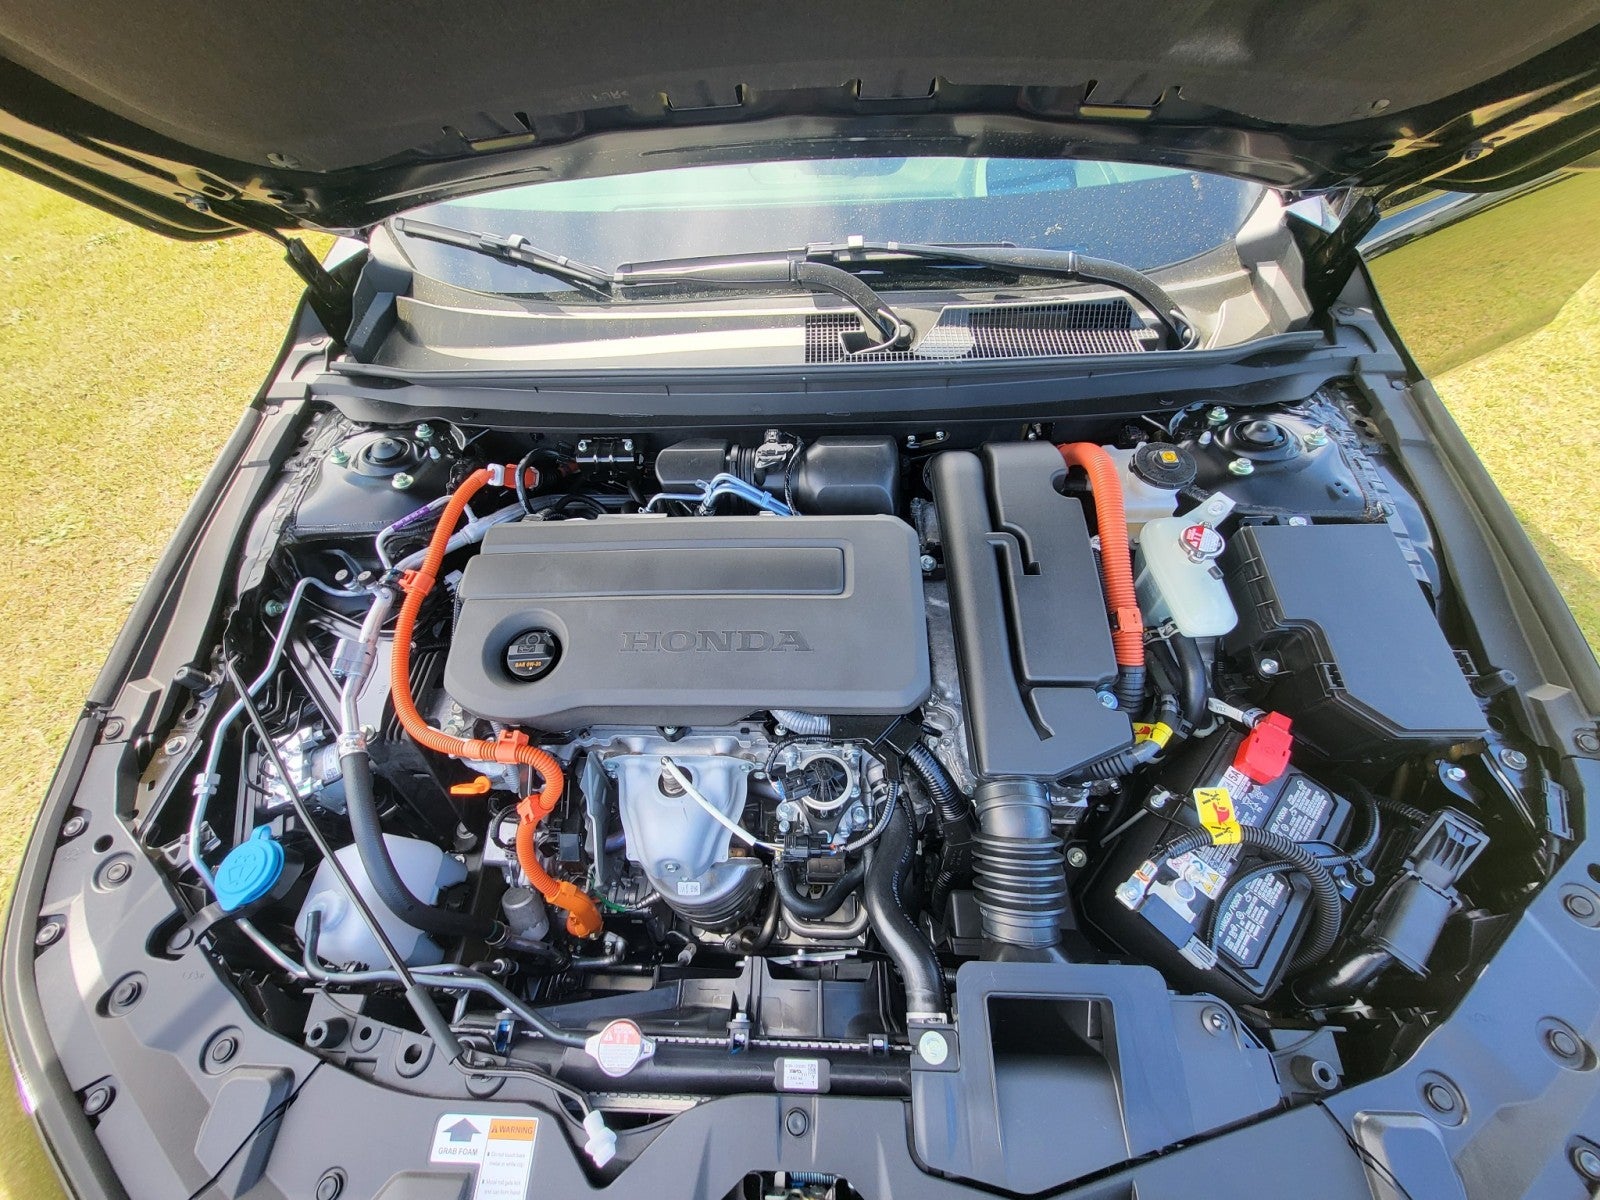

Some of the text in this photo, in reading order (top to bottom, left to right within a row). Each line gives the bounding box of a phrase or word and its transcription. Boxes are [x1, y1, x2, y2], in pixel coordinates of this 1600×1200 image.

[619, 630, 815, 652] HONDA
[499, 1126, 534, 1135] WARNING
[438, 1147, 458, 1155] GRAB
[459, 1148, 479, 1156] FOAM
